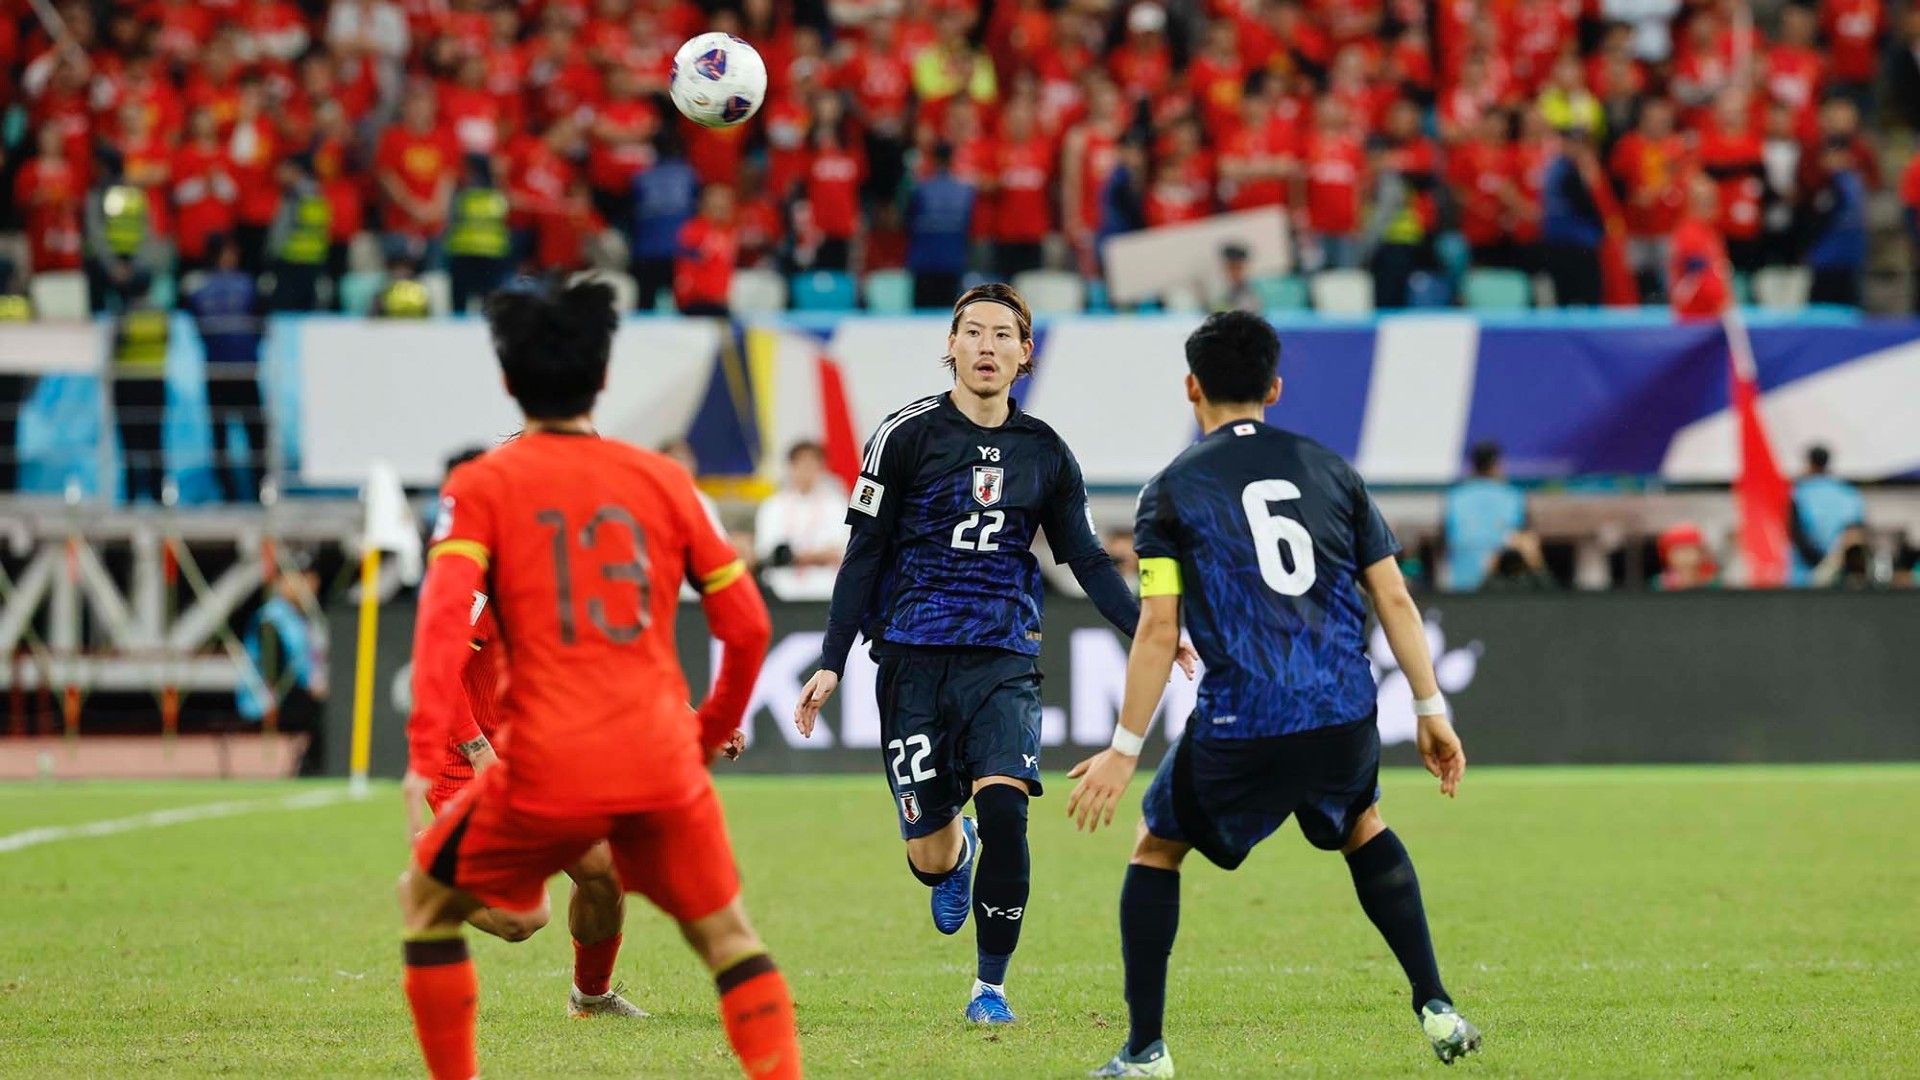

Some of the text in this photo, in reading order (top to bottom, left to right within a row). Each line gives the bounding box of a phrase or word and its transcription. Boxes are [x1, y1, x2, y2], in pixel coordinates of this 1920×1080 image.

[977, 445, 1001, 462] Y-3
[950, 509, 1006, 552] 22
[1241, 479, 1317, 597] 6
[536, 504, 653, 645] 13
[888, 733, 937, 786] 22
[980, 901, 1023, 920] Y-3
